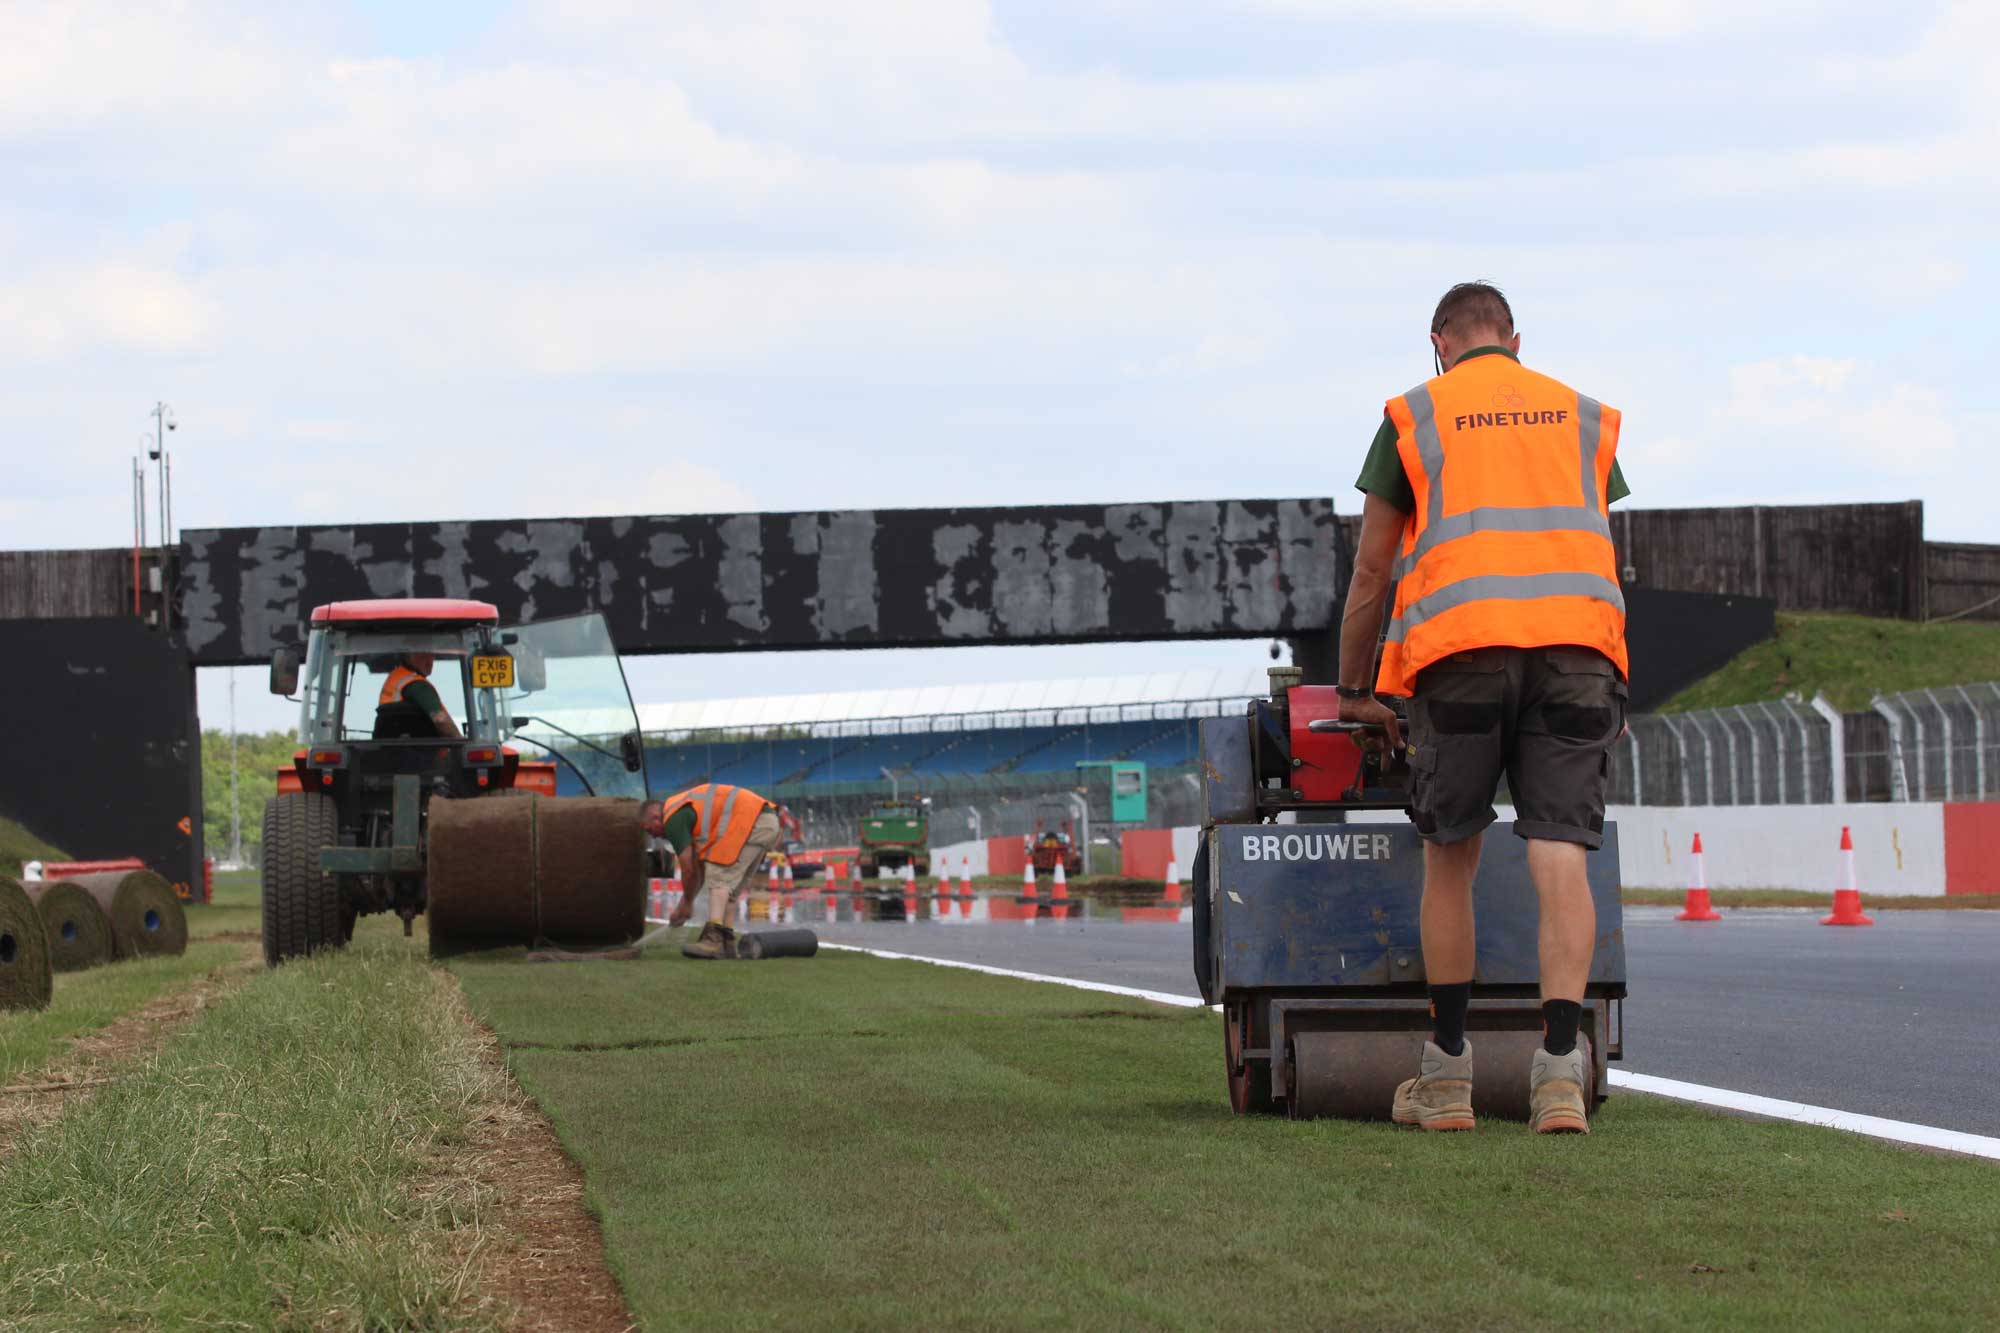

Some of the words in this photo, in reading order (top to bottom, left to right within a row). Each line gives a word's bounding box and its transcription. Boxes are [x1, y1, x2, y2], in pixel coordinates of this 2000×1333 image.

[1455, 410, 1568, 431] FINETURF
[478, 659, 508, 671] FX16
[479, 672, 507, 684] CYP
[1242, 834, 1391, 861] BROUWER
